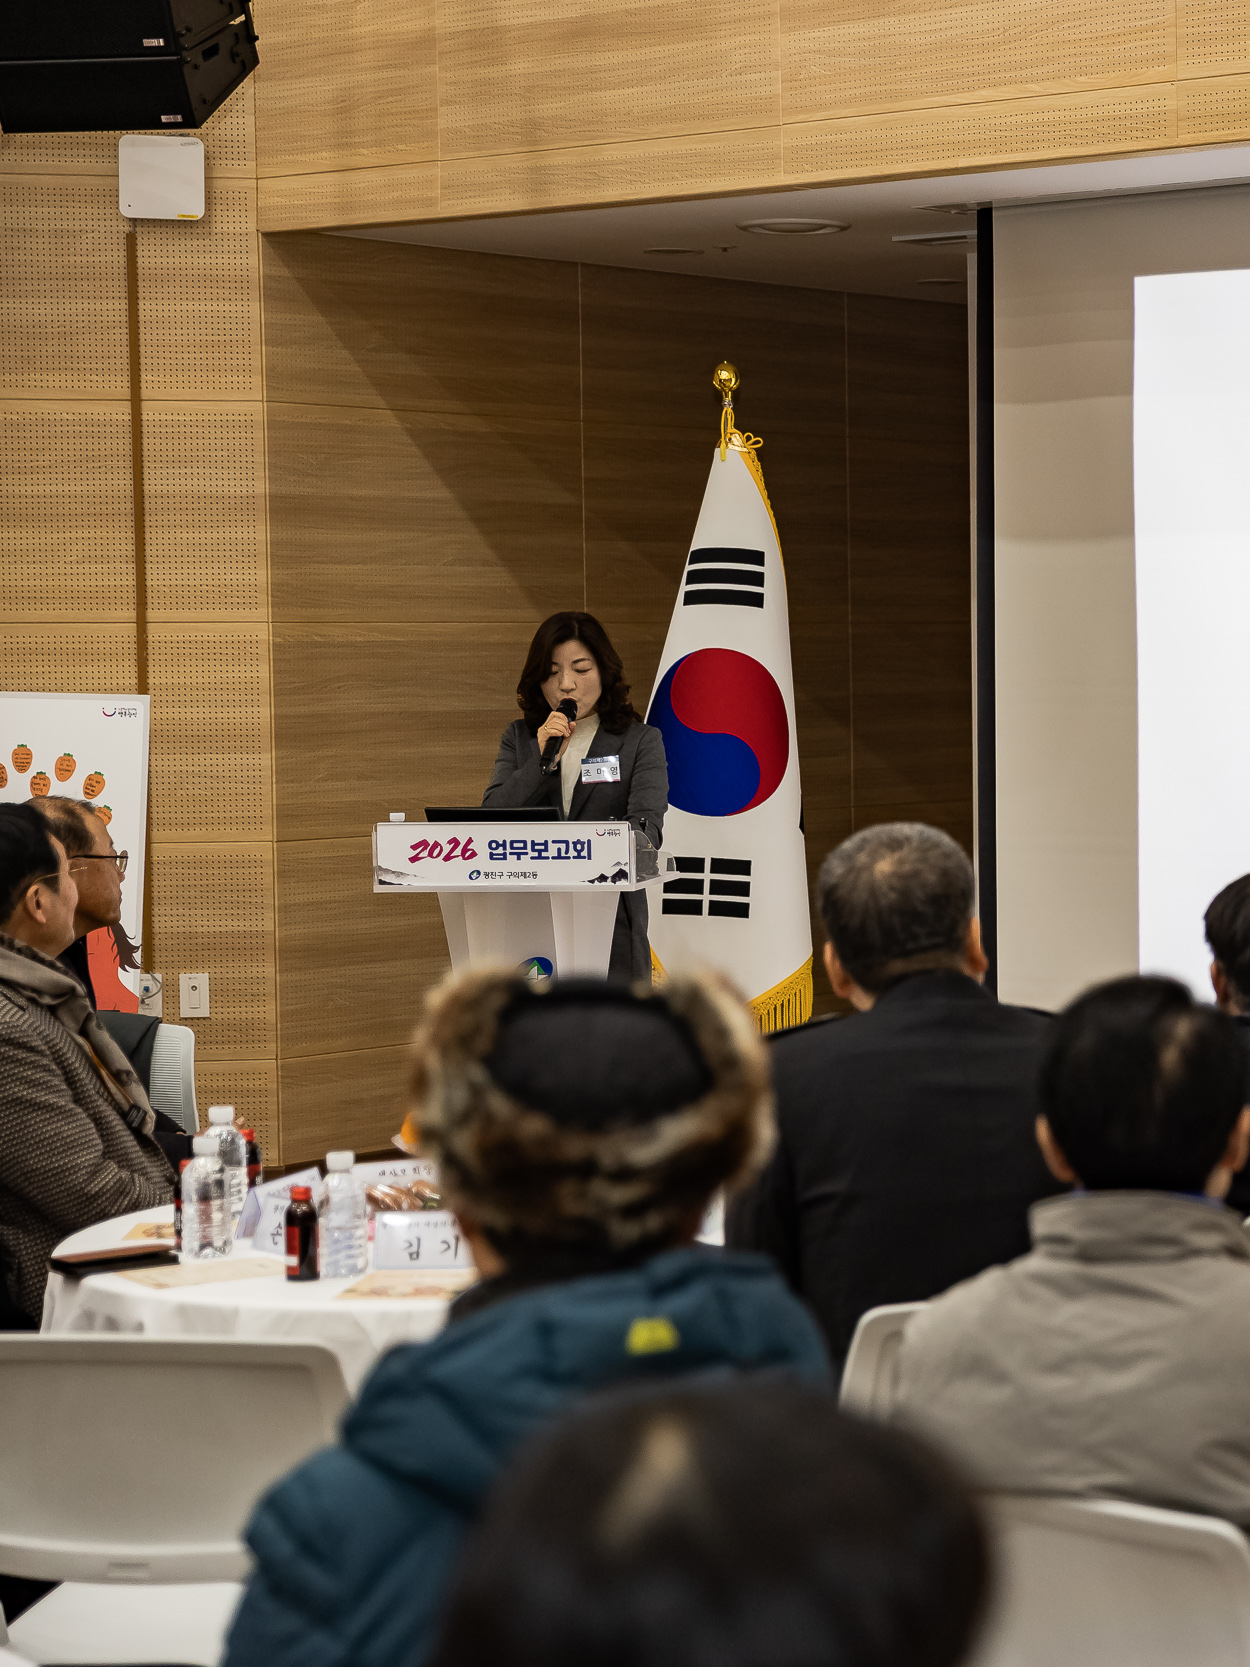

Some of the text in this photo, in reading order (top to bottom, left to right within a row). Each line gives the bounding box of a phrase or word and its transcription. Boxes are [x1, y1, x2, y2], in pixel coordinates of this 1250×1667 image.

[409, 837, 592, 863] 2026 업무보고회
[483, 871, 538, 880] 광진구 구의제2동
